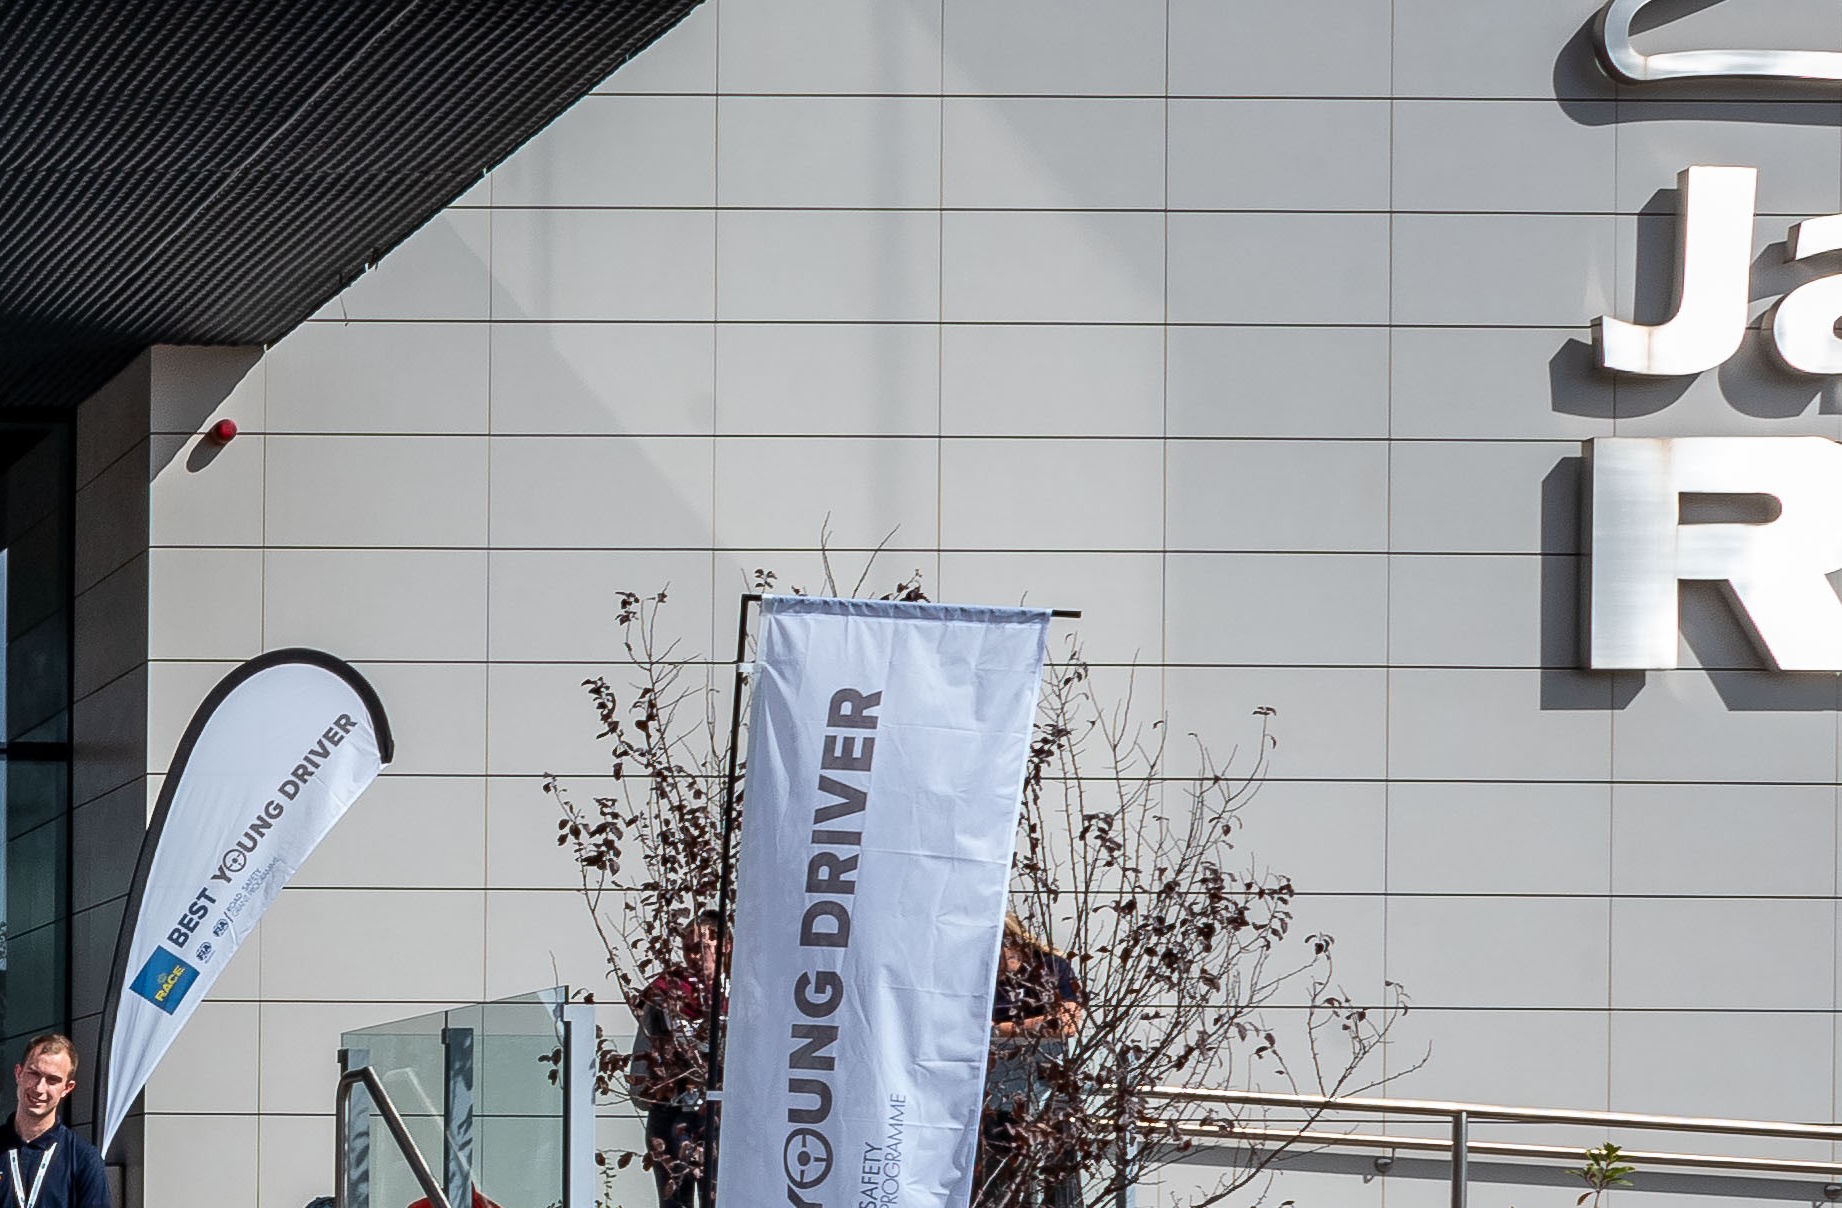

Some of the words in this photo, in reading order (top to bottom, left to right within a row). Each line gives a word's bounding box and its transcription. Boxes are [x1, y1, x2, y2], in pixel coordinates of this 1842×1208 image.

[166, 887, 217, 949] BEST
[210, 799, 284, 885] YOUNG
[277, 712, 358, 802] DRIVER
[799, 686, 883, 950] DRIVER
[154, 964, 185, 1003] RACE
